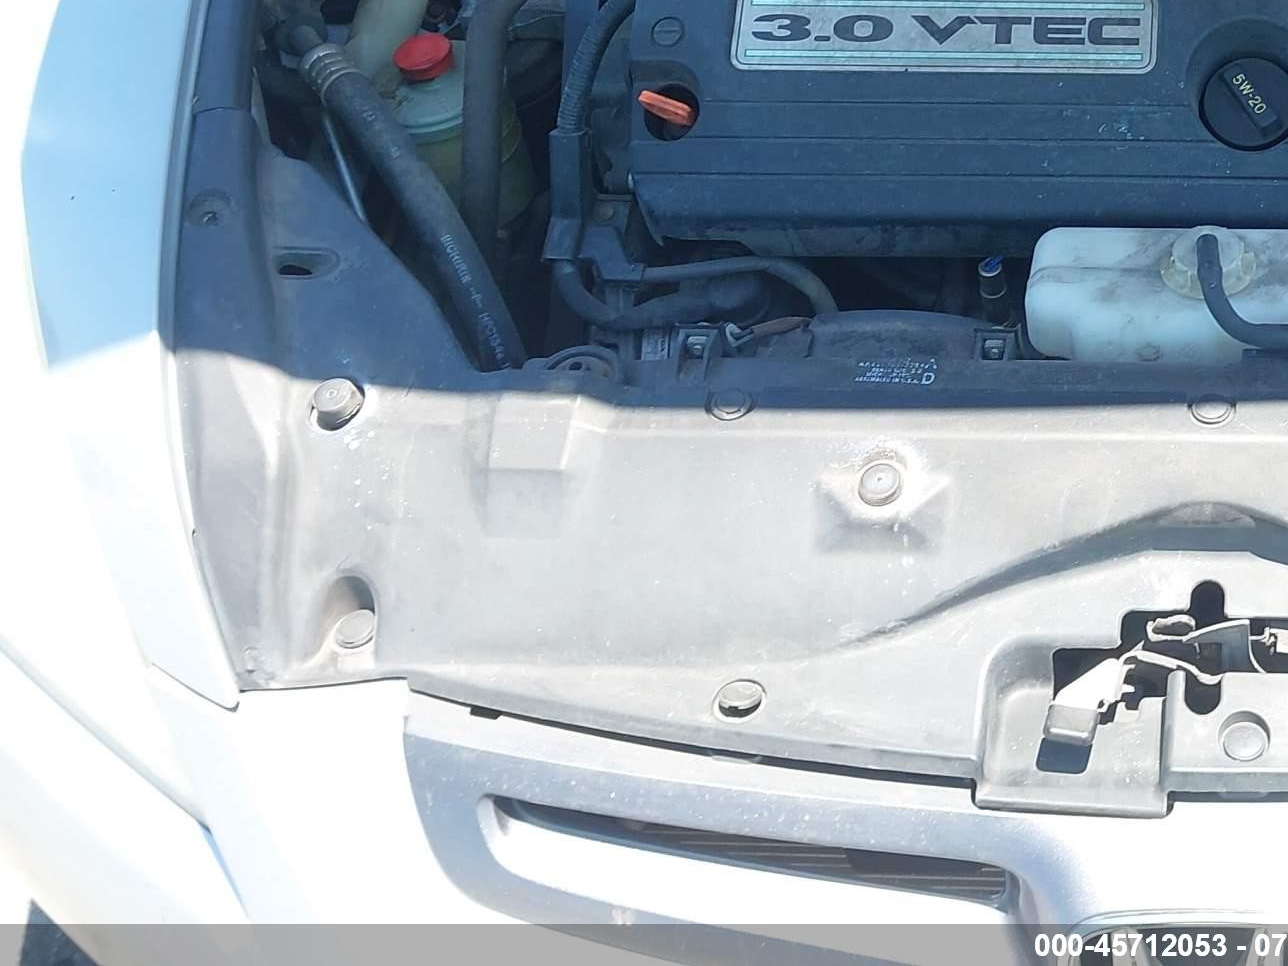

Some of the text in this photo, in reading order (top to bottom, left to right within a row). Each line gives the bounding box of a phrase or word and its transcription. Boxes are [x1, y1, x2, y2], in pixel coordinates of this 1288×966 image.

[751, 14, 1141, 45] 3.0 VTEC
[1232, 73, 1267, 114] 5W-20
